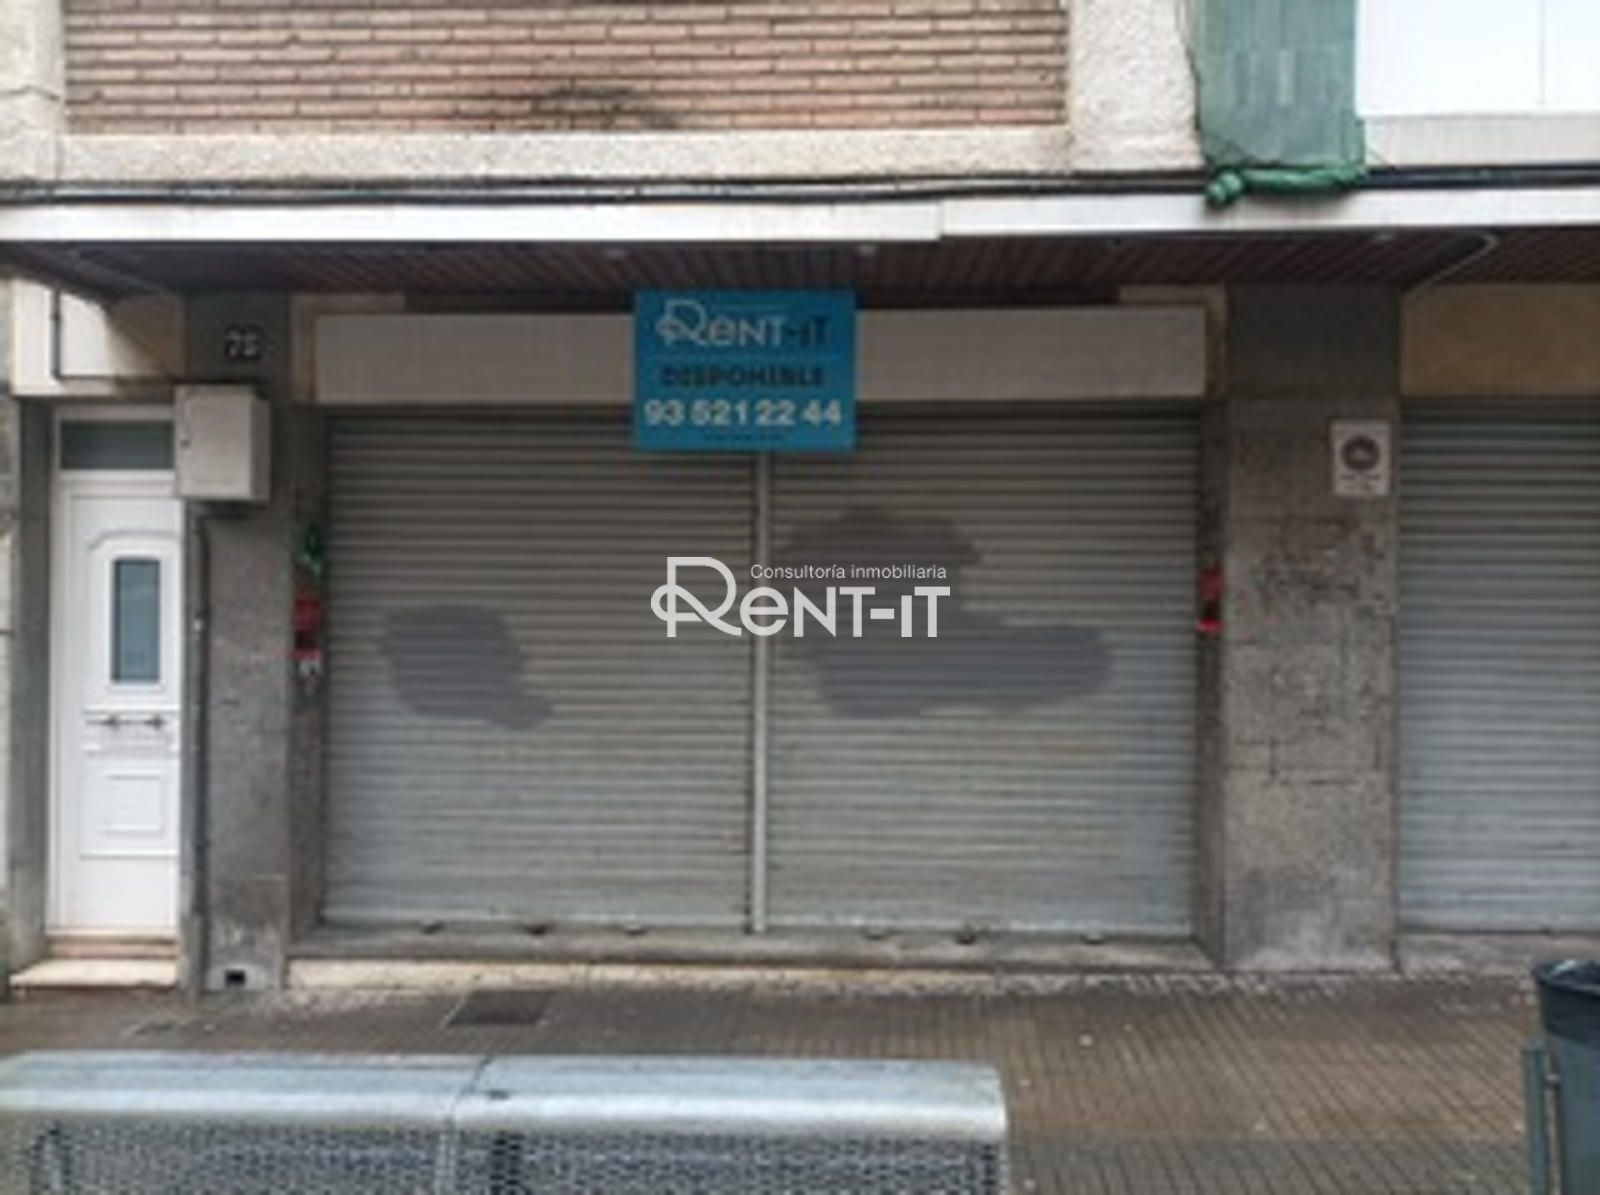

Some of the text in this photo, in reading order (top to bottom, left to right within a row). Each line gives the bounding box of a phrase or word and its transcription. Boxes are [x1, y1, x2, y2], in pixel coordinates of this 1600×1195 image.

[661, 364, 824, 386] DISPONIBLE
[644, 399, 843, 427] 93 521 22 44
